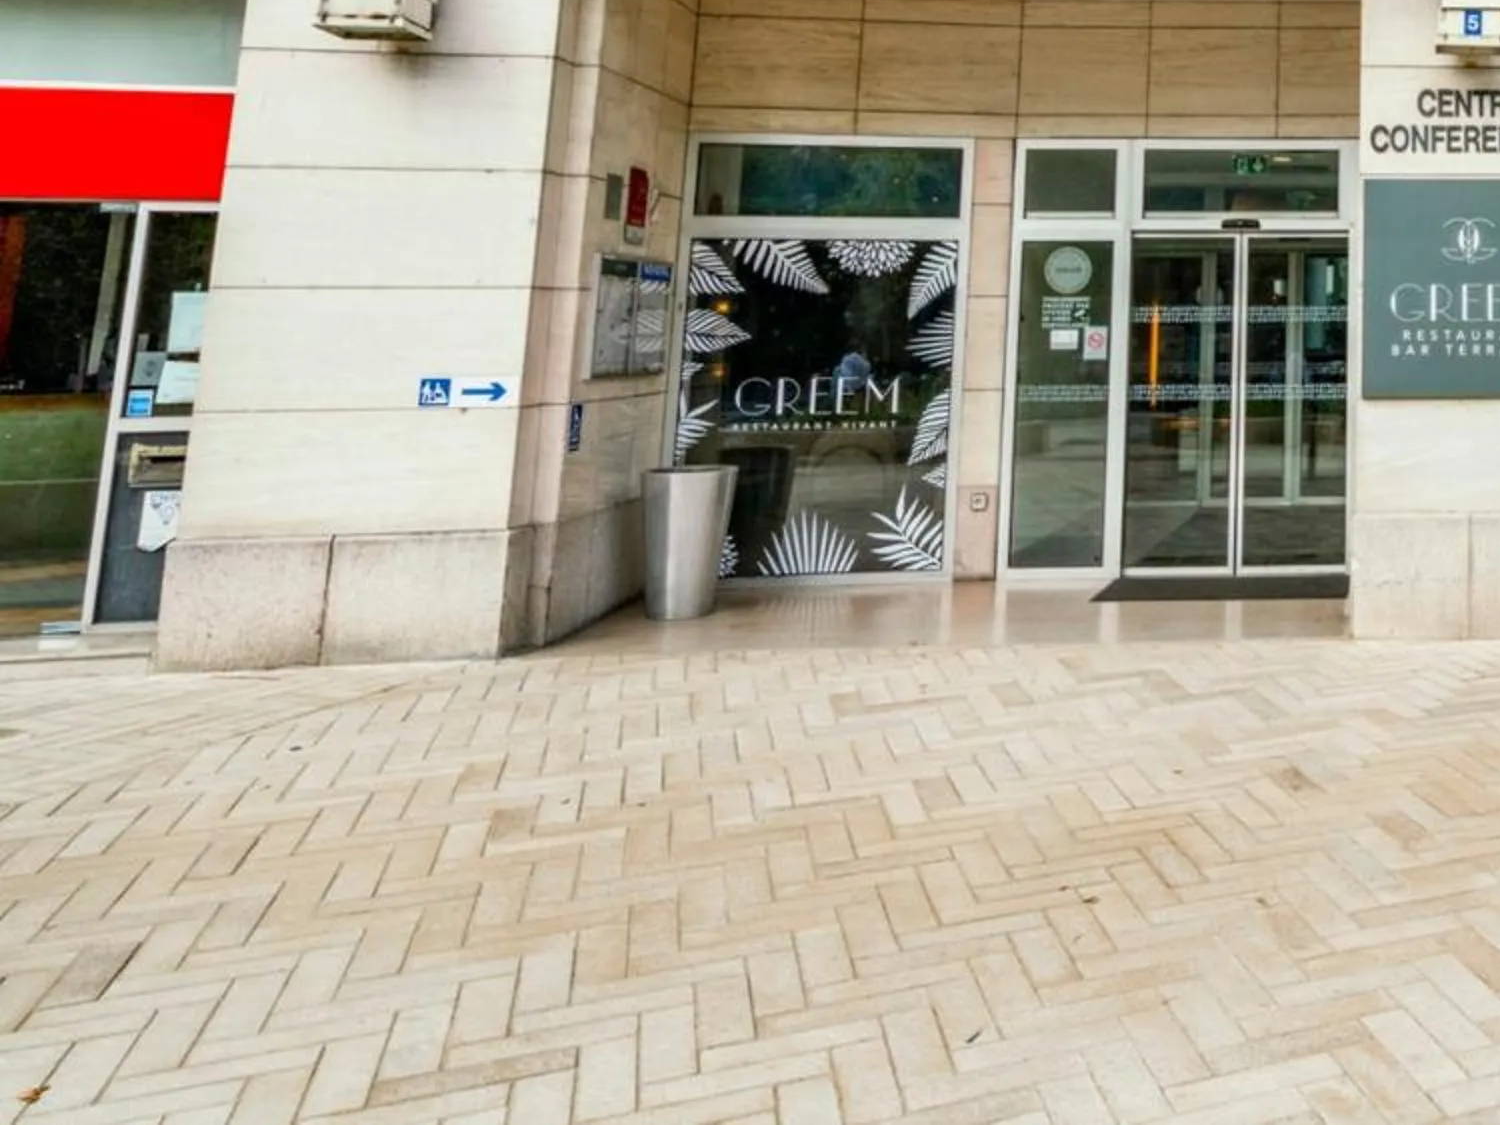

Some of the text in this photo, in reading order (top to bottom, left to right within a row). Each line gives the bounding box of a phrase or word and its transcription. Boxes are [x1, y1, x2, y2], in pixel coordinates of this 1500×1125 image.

[1467, 13, 1480, 31] 5
[1390, 343, 1431, 357] BAR
[734, 376, 902, 417] GREEM
